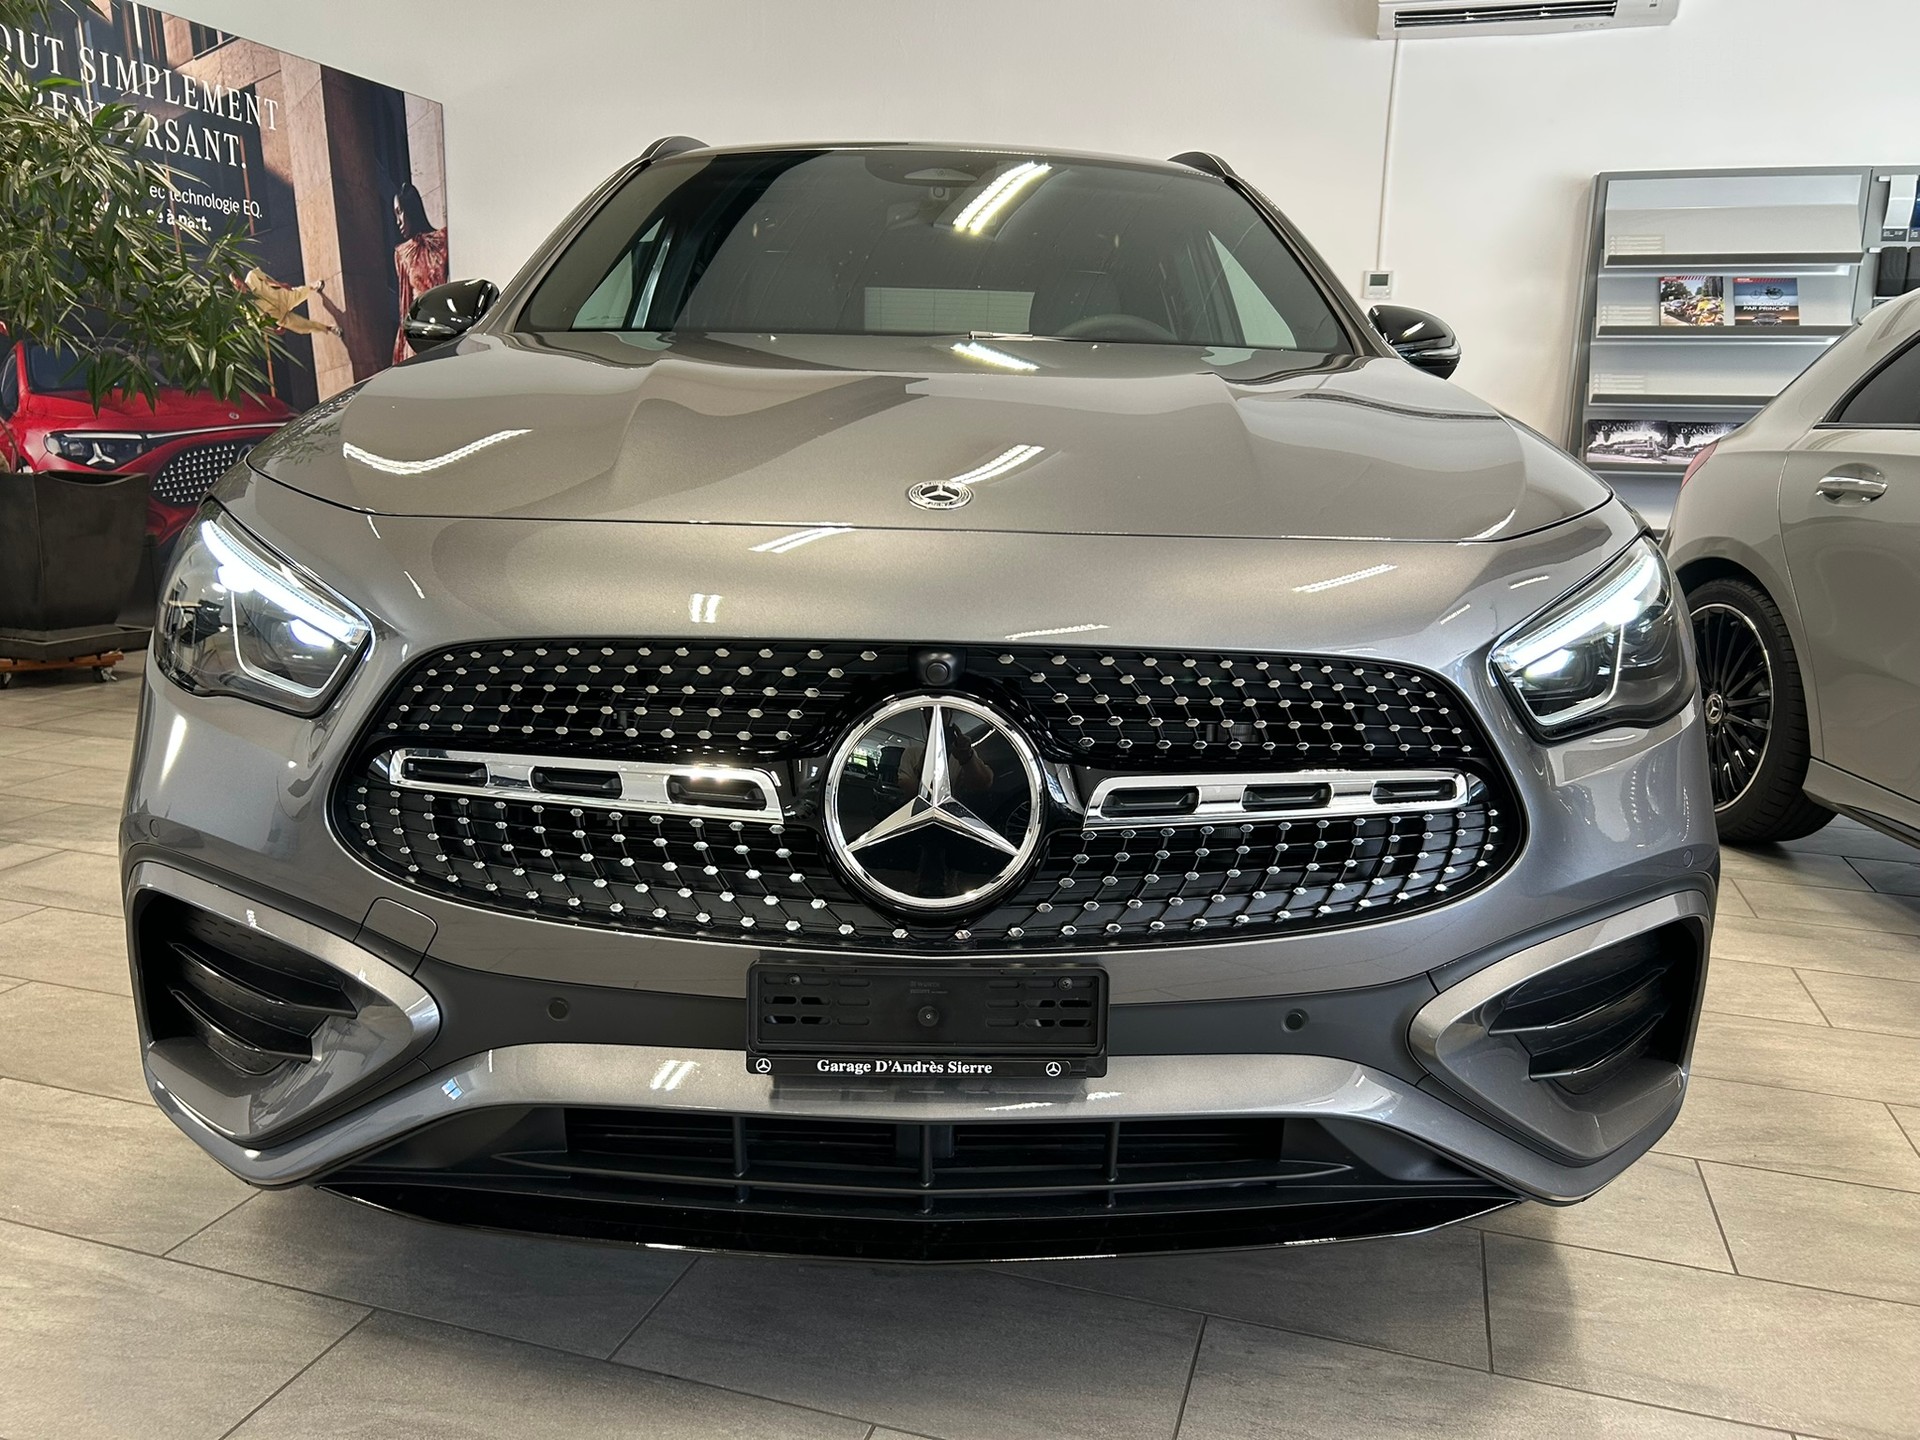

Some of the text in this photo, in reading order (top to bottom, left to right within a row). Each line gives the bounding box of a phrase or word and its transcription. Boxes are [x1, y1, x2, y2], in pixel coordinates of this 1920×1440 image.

[80, 46, 279, 131] SIMPLEMENT
[169, 188, 240, 215] technologie
[243, 199, 263, 219] EQ.
[166, 208, 176, 226] à
[816, 1059, 993, 1075] Garage D'Andrès Sierre
